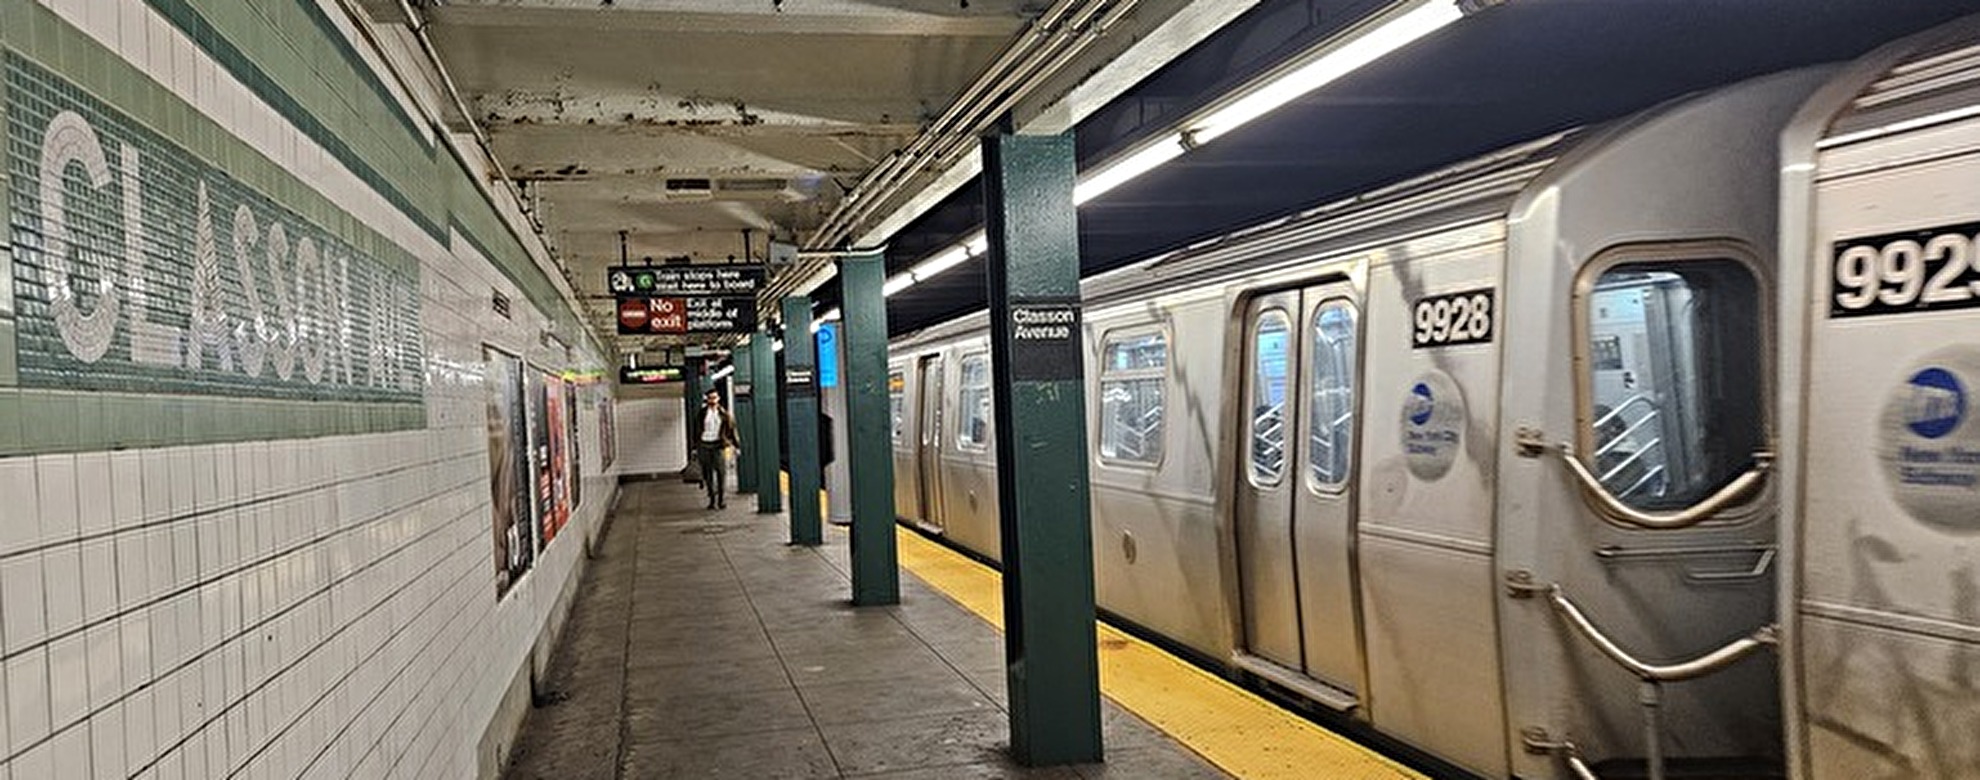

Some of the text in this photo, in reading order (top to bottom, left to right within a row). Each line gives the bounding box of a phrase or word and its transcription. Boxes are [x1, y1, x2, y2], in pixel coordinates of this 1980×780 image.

[40, 109, 354, 385] CLASSON
[655, 268, 740, 281] Train stops here
[655, 278, 755, 290] wait here to board
[650, 297, 674, 313] No
[710, 298, 722, 307] at
[687, 308, 738, 318] middle of
[1013, 307, 1075, 324] Classon
[1415, 293, 1490, 343] 9928
[651, 314, 682, 329] exit
[687, 319, 734, 331] platform
[1014, 325, 1070, 339] Avenue
